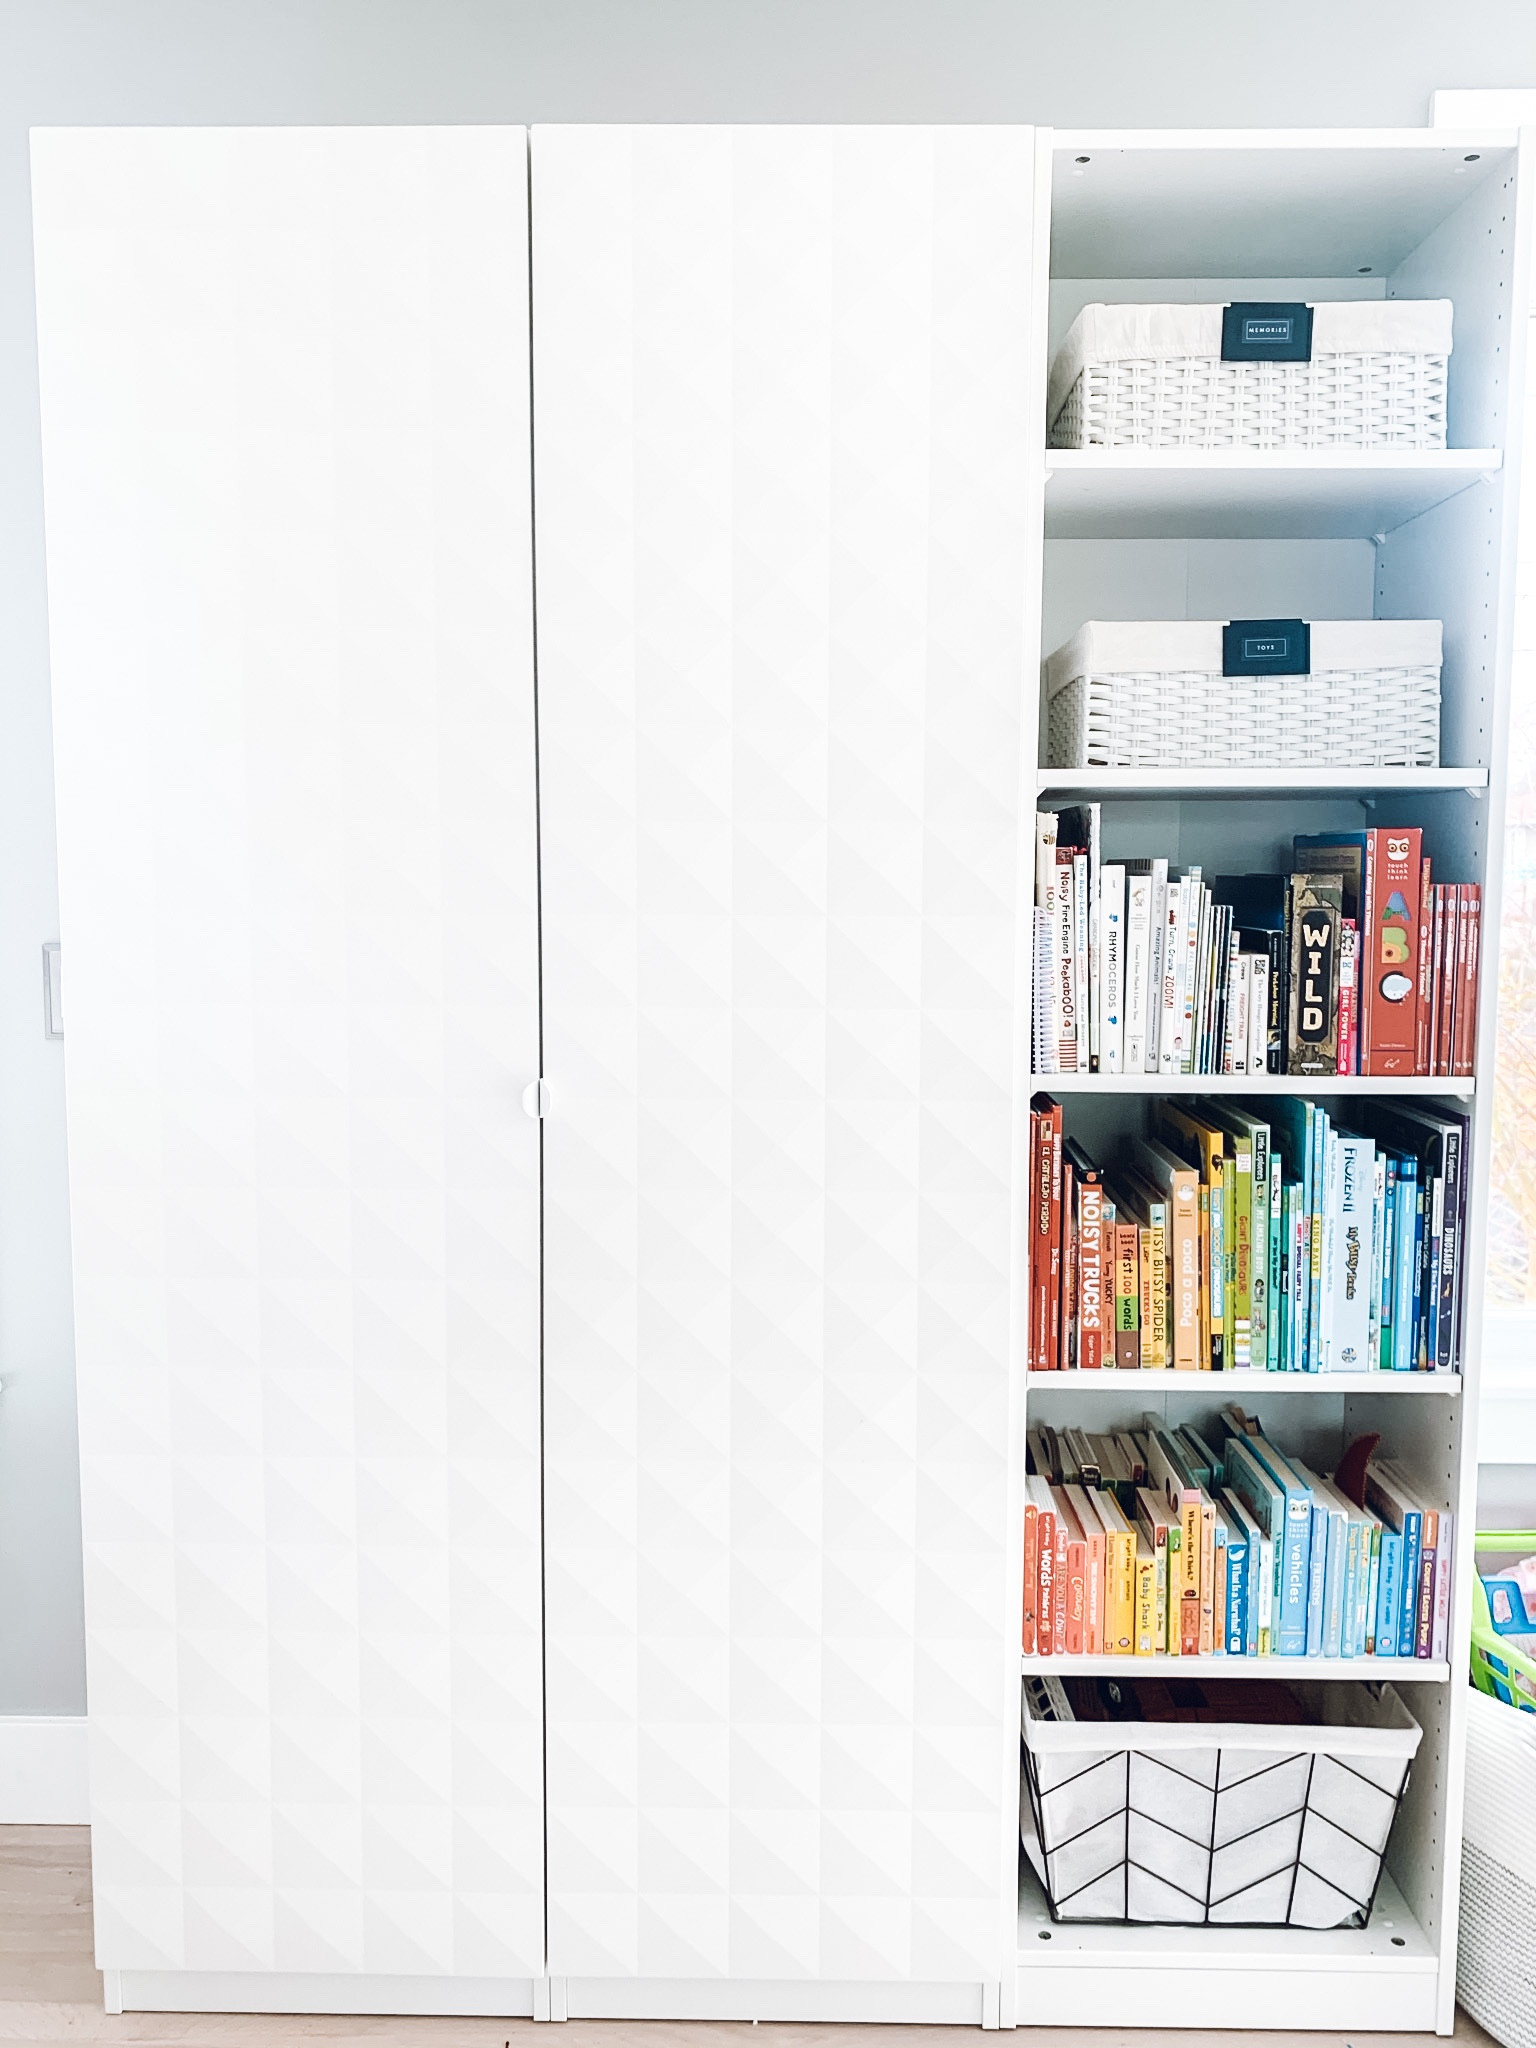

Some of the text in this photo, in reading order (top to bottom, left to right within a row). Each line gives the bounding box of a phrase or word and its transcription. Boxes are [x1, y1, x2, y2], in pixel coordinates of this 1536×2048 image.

[1059, 871, 1070, 901] Noisy
[1061, 904, 1070, 923] Fire
[1060, 924, 1070, 954] Engine
[1078, 918, 1086, 952] Weaning
[1153, 926, 1161, 955] Amazing
[1108, 931, 1117, 1008] RHYMOCEROS
[1302, 924, 1330, 1031] WILD
[1164, 975, 1175, 1009] ZOOM!
[1341, 989, 1349, 1041] GIRL POWER
[1255, 1133, 1266, 1181] Little Explorers
[1446, 1136, 1458, 1184] Little Explorers
[1040, 1146, 1050, 1235] EL CATALEJO PERDIDO
[1342, 1147, 1357, 1213] FROZEN II
[1312, 1219, 1320, 1244] KING
[1081, 1190, 1100, 1328] NOISY TRUCKS
[1430, 1259, 1438, 1269] My
[1442, 1227, 1454, 1276] DINOSAURS
[1104, 1278, 1113, 1305] YUCKY
[1122, 1247, 1134, 1330] first 100 words
[1153, 1227, 1164, 1342] ITSY BITSY SPIDER
[1179, 1238, 1193, 1327] Poco a poco
[1143, 1314, 1150, 1325] GO
[1187, 1510, 1195, 1541] Where's
[1387, 1541, 1395, 1565] bright
[1056, 1564, 1066, 1581] ARE
[1231, 1563, 1242, 1584] What
[1289, 1543, 1304, 1604] vehicles
[1311, 1562, 1321, 1606] FRIENDS
[1056, 1583, 1065, 1601] YOU
[1140, 1576, 1151, 1630] Baby Shark
[1055, 1611, 1065, 1639] COW?
[1230, 1598, 1241, 1636] Narwhal?
